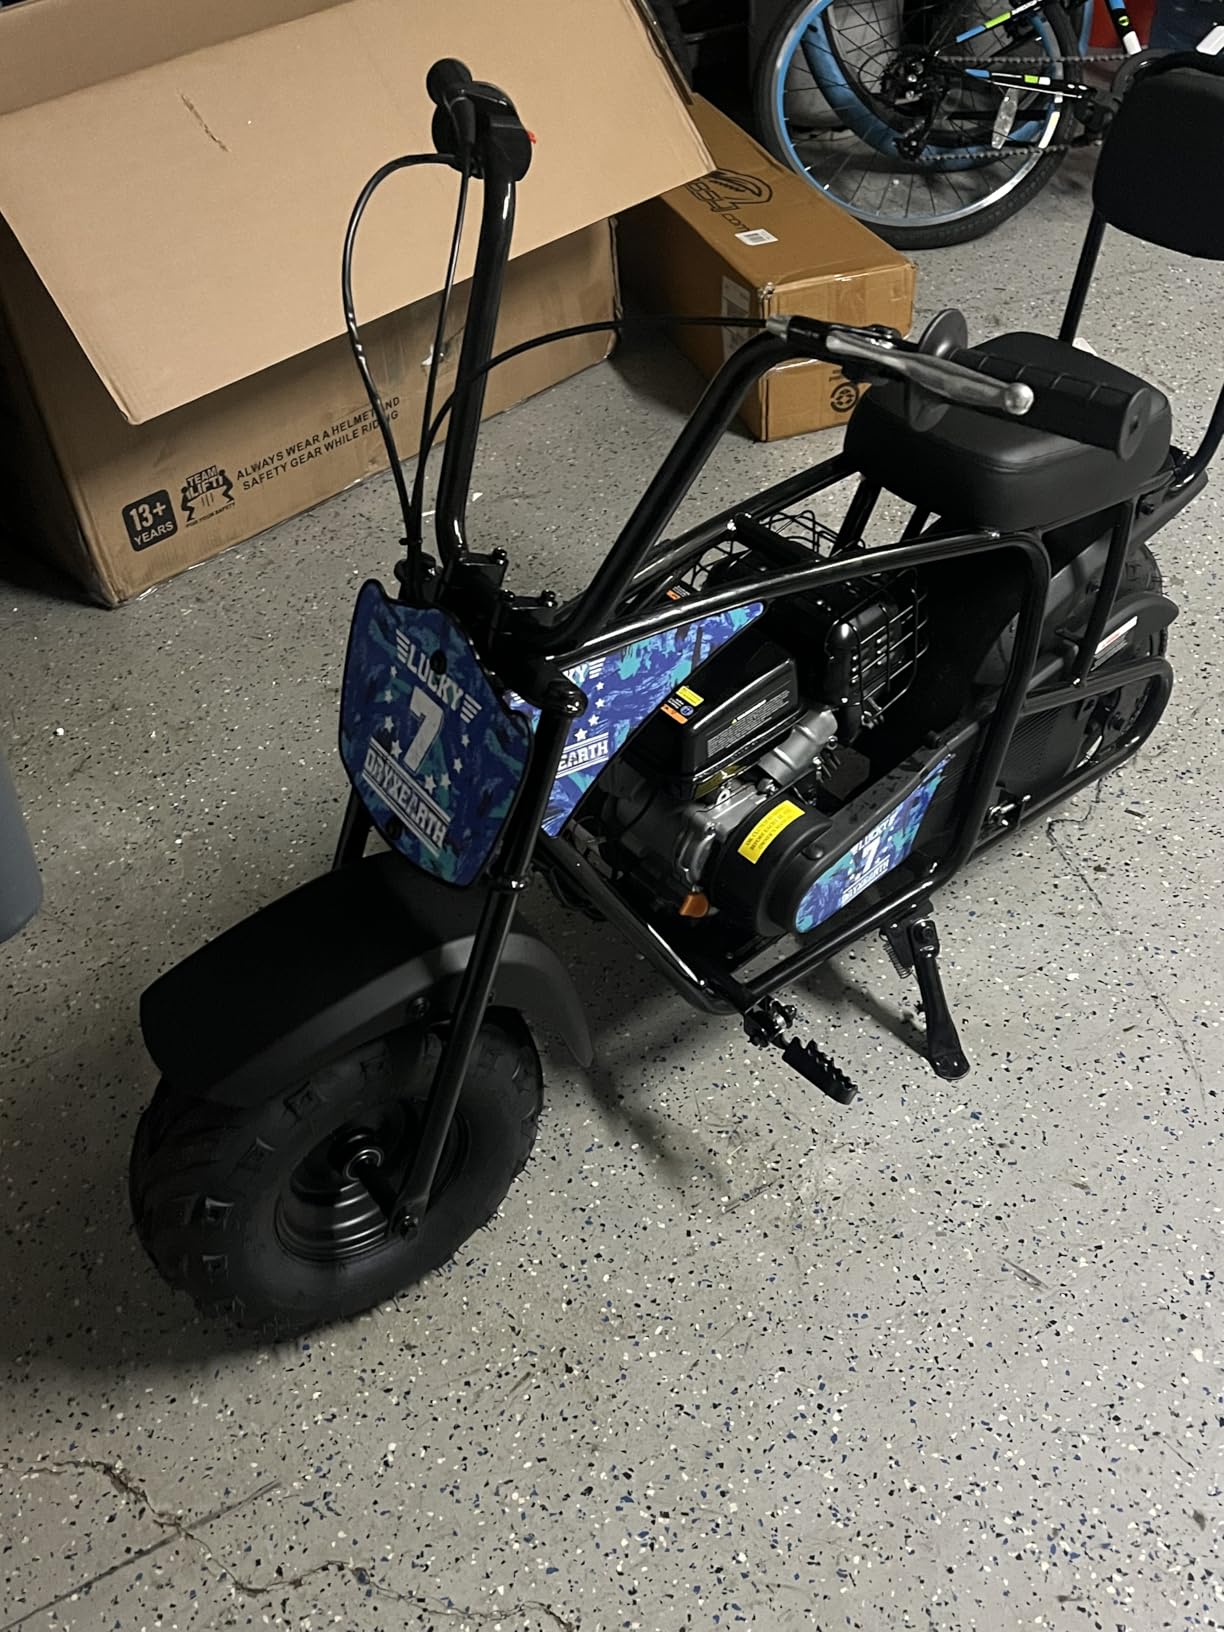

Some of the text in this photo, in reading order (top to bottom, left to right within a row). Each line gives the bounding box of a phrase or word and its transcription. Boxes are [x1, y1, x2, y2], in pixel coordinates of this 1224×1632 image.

[237, 452, 284, 480] ALWAYS
[286, 434, 321, 456] WEAR
[322, 430, 331, 441] A
[242, 410, 399, 490] SAFETY GEAR WHILE RIDG
[187, 467, 218, 487] TEAM
[129, 502, 166, 531] 13+
[133, 521, 174, 545] YEARS
[407, 643, 465, 711] LUCKY
[404, 686, 444, 773] 7
[861, 836, 881, 873] 7
